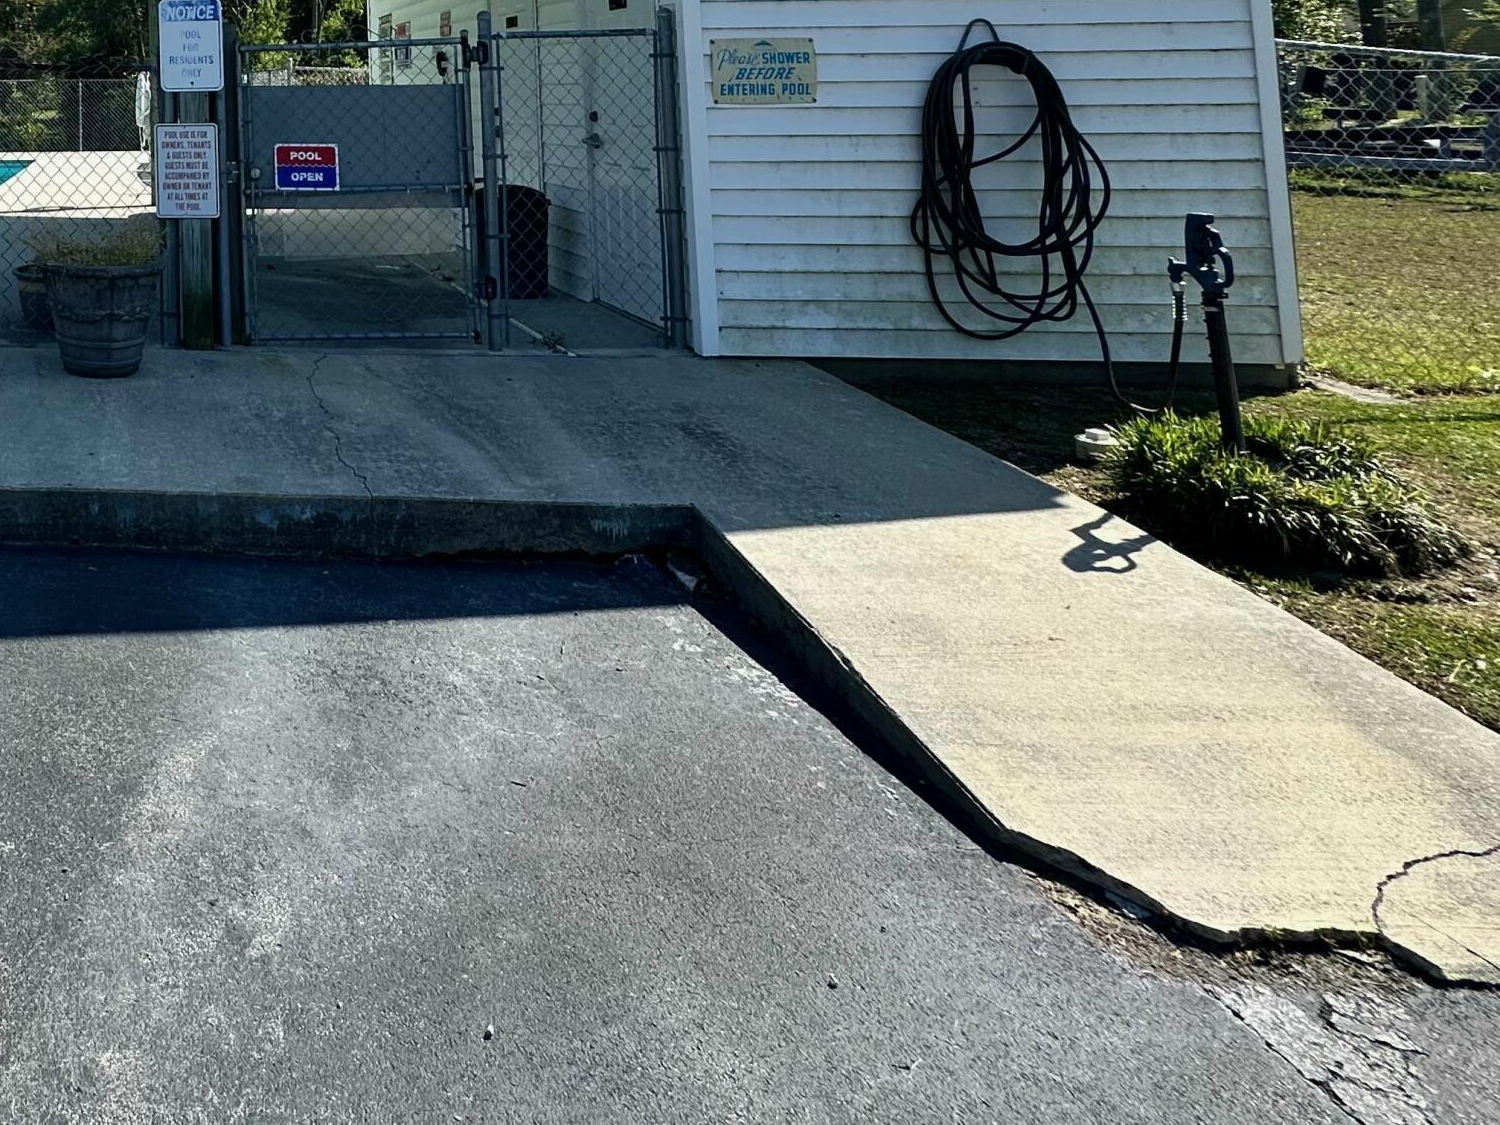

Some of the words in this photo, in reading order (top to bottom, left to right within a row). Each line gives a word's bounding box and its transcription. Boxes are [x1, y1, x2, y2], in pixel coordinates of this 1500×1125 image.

[165, 5, 215, 21] NOTICE
[169, 55, 215, 65] RESIDENTS
[717, 48, 759, 71] Please
[761, 51, 810, 65] SHOWER
[181, 67, 202, 77] ONLY
[735, 66, 796, 80] BEFORE
[720, 82, 775, 96] ENTERING
[781, 82, 812, 96] POOL
[289, 151, 322, 161] POOL
[290, 172, 324, 182] OPEN
